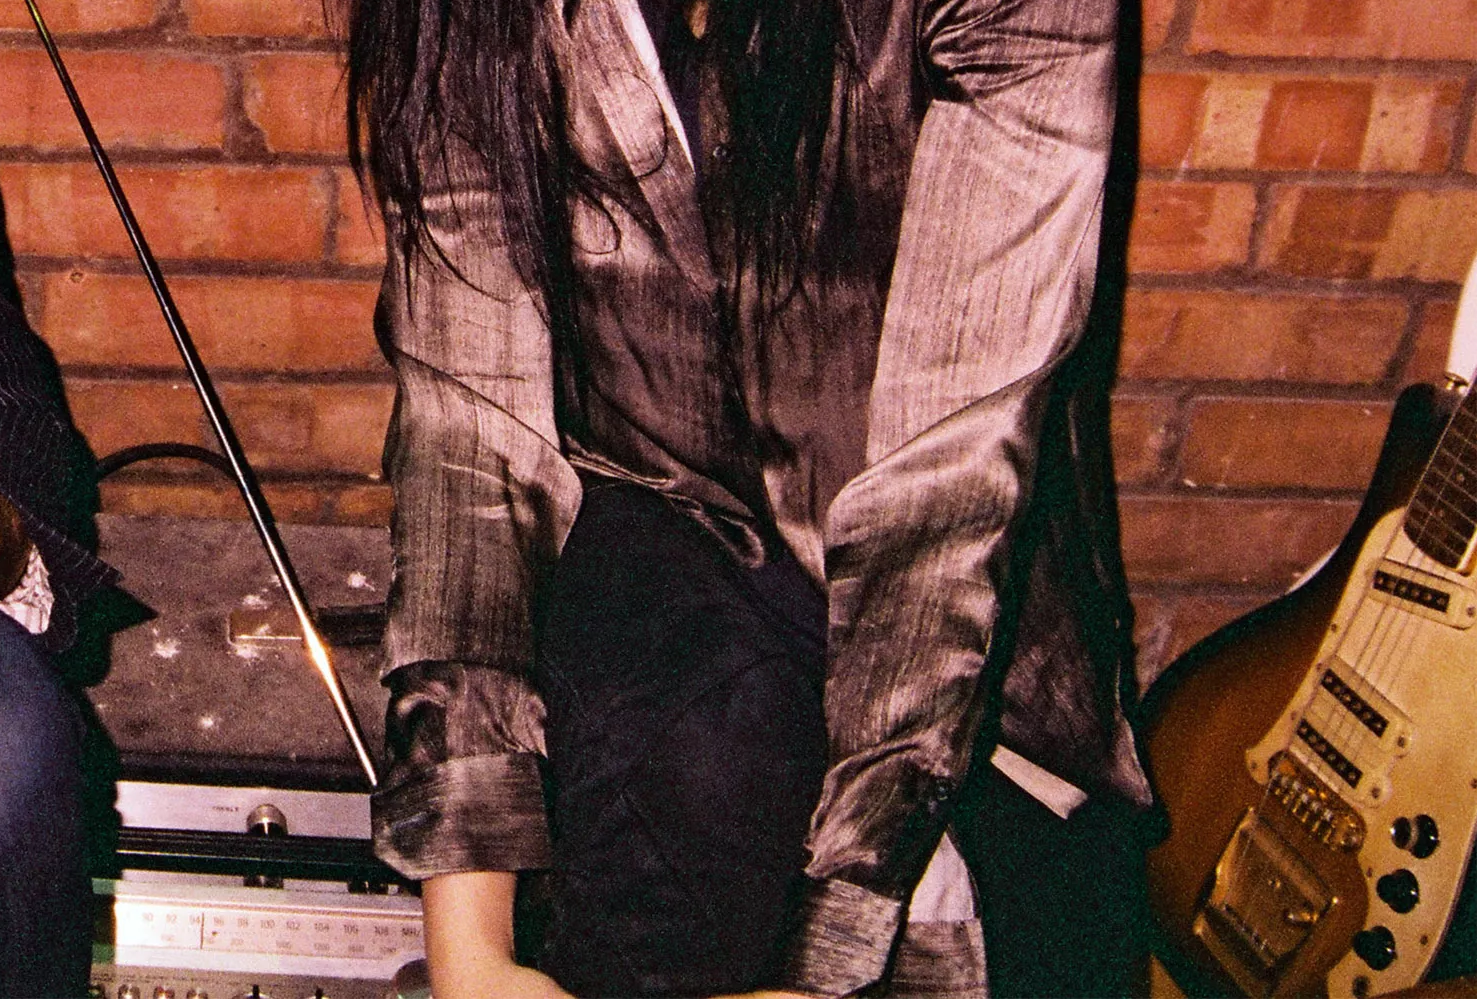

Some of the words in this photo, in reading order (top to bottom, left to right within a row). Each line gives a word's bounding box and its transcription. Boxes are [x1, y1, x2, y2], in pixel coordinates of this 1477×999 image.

[260, 919, 275, 930] 100
[286, 920, 301, 931] 102
[343, 923, 359, 935] 106
